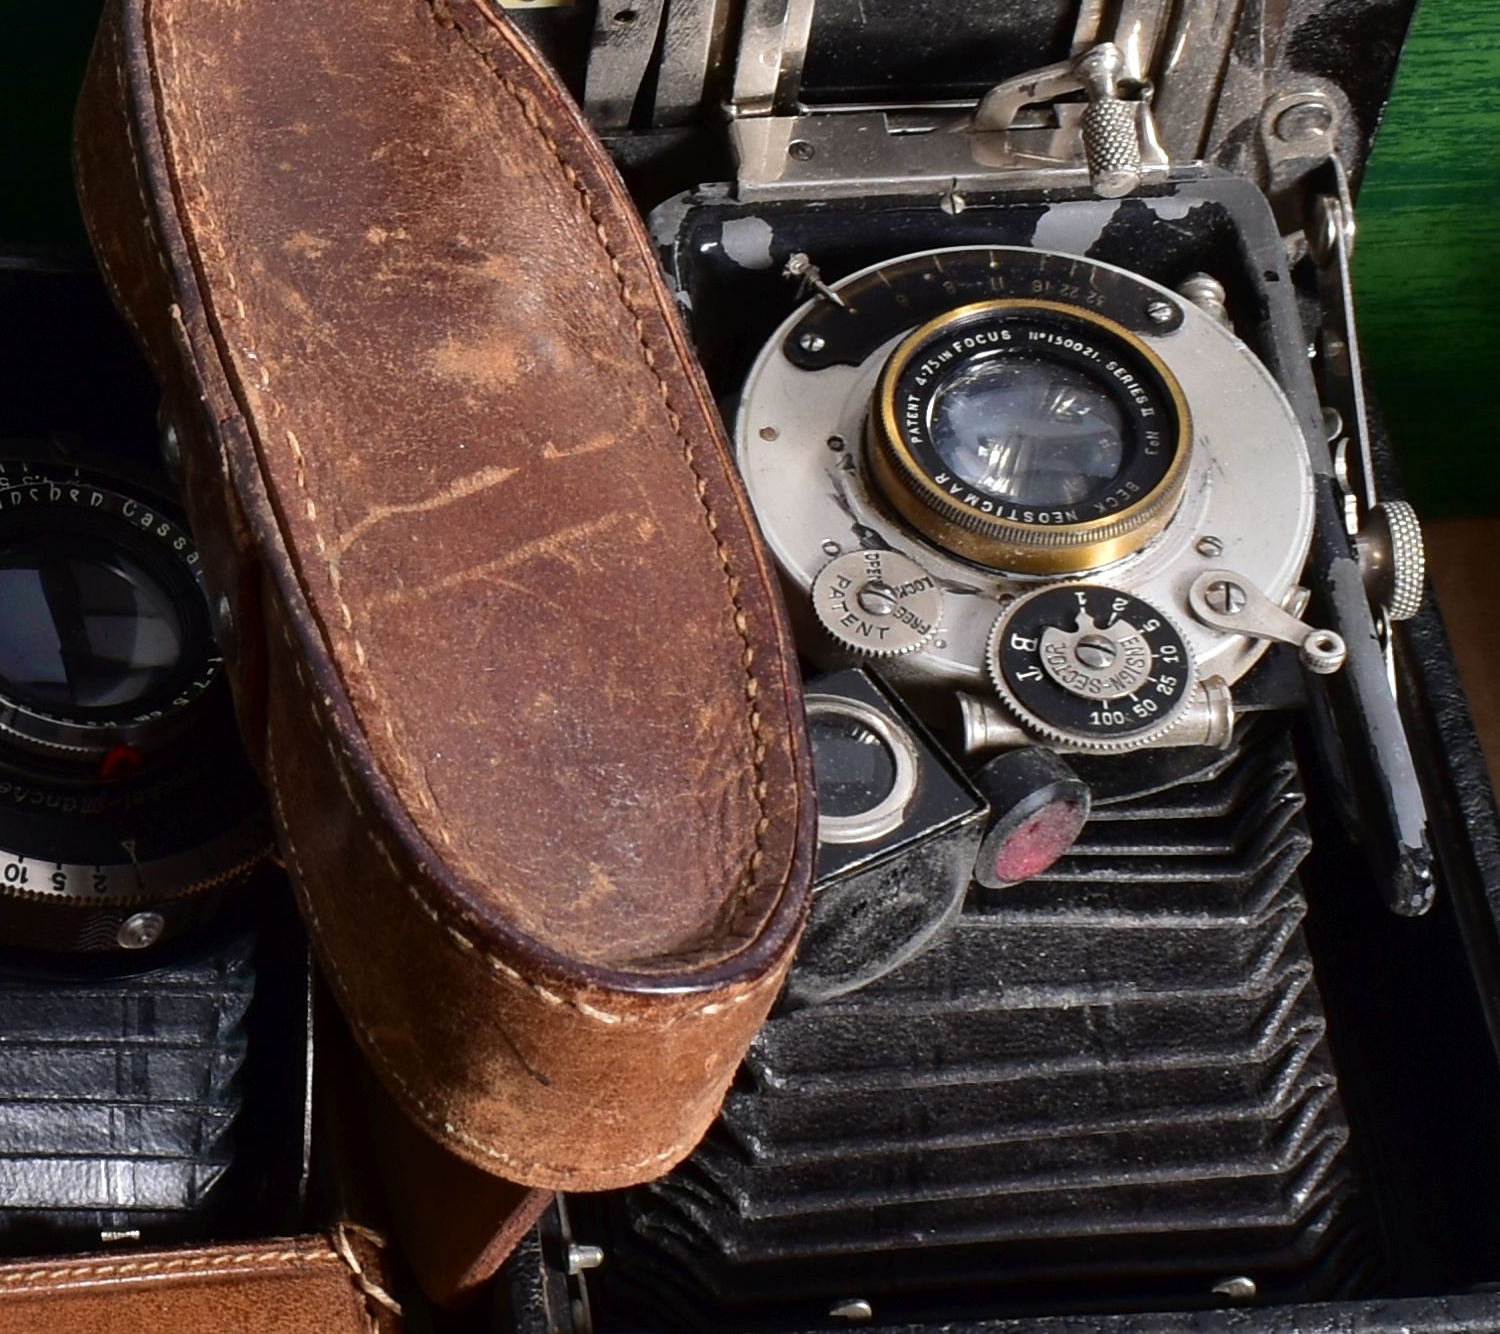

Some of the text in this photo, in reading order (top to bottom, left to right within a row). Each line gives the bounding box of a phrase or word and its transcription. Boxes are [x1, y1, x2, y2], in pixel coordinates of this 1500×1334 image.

[951, 329, 1012, 353] FOCUS
[1105, 361, 1149, 405] SERIES
[906, 393, 924, 444] PATENT
[1094, 480, 1141, 515] BECK
[827, 575, 890, 640] PATENT
[1075, 591, 1087, 605] 1
[1111, 597, 1128, 612] 2
[893, 605, 932, 636] FREE
[1143, 619, 1160, 633] 5
[1010, 633, 1039, 652] B
[1159, 645, 1179, 664] 10
[1156, 674, 1177, 696] 25
[1089, 711, 1125, 725] 100
[1132, 698, 1158, 718] 50
[4, 863, 28, 885] 10
[52, 872, 68, 892] 5
[93, 875, 109, 894] 2
